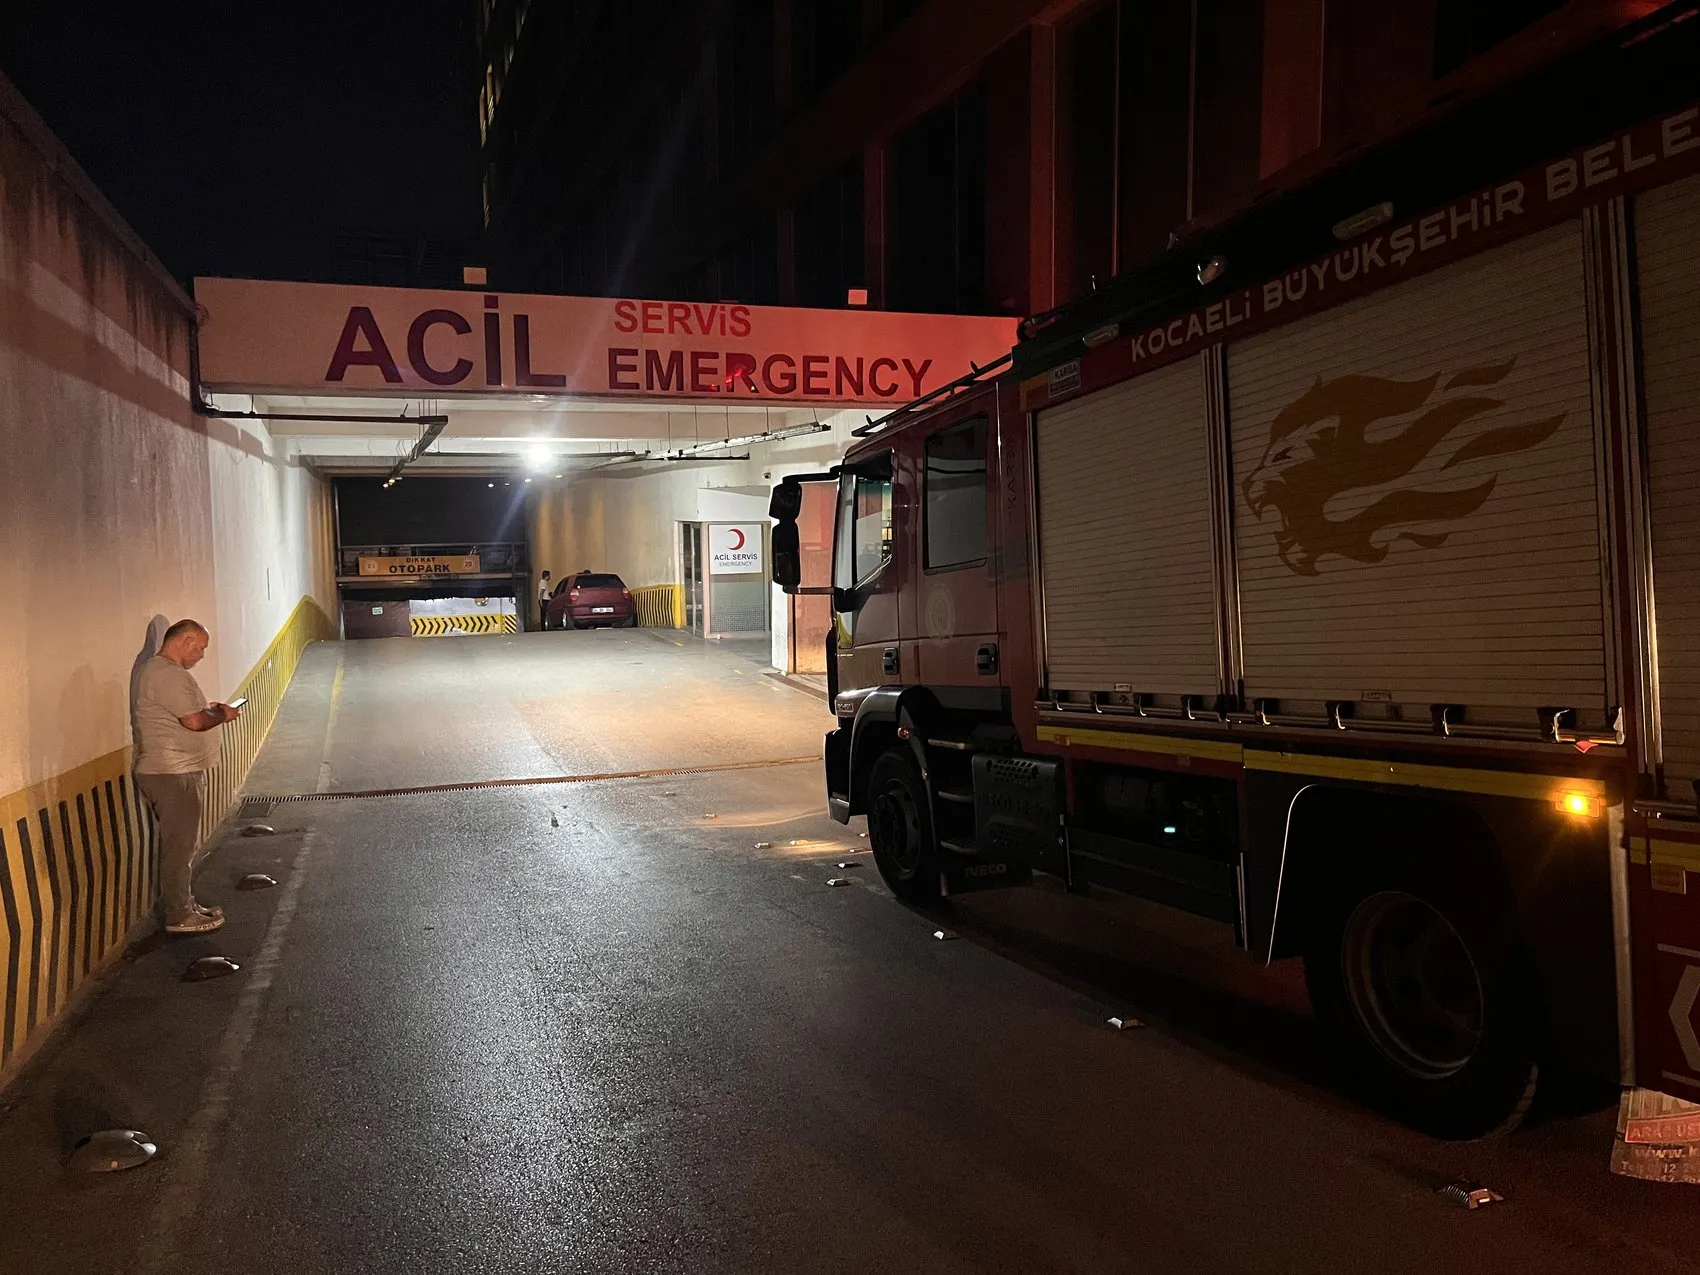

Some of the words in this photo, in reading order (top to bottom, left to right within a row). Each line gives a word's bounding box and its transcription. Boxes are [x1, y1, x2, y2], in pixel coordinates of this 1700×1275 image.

[324, 294, 567, 387] ACİL
[607, 347, 934, 399] EMERGENCY
[388, 564, 451, 574] OTOPARK
[964, 863, 1007, 878] IVECO
